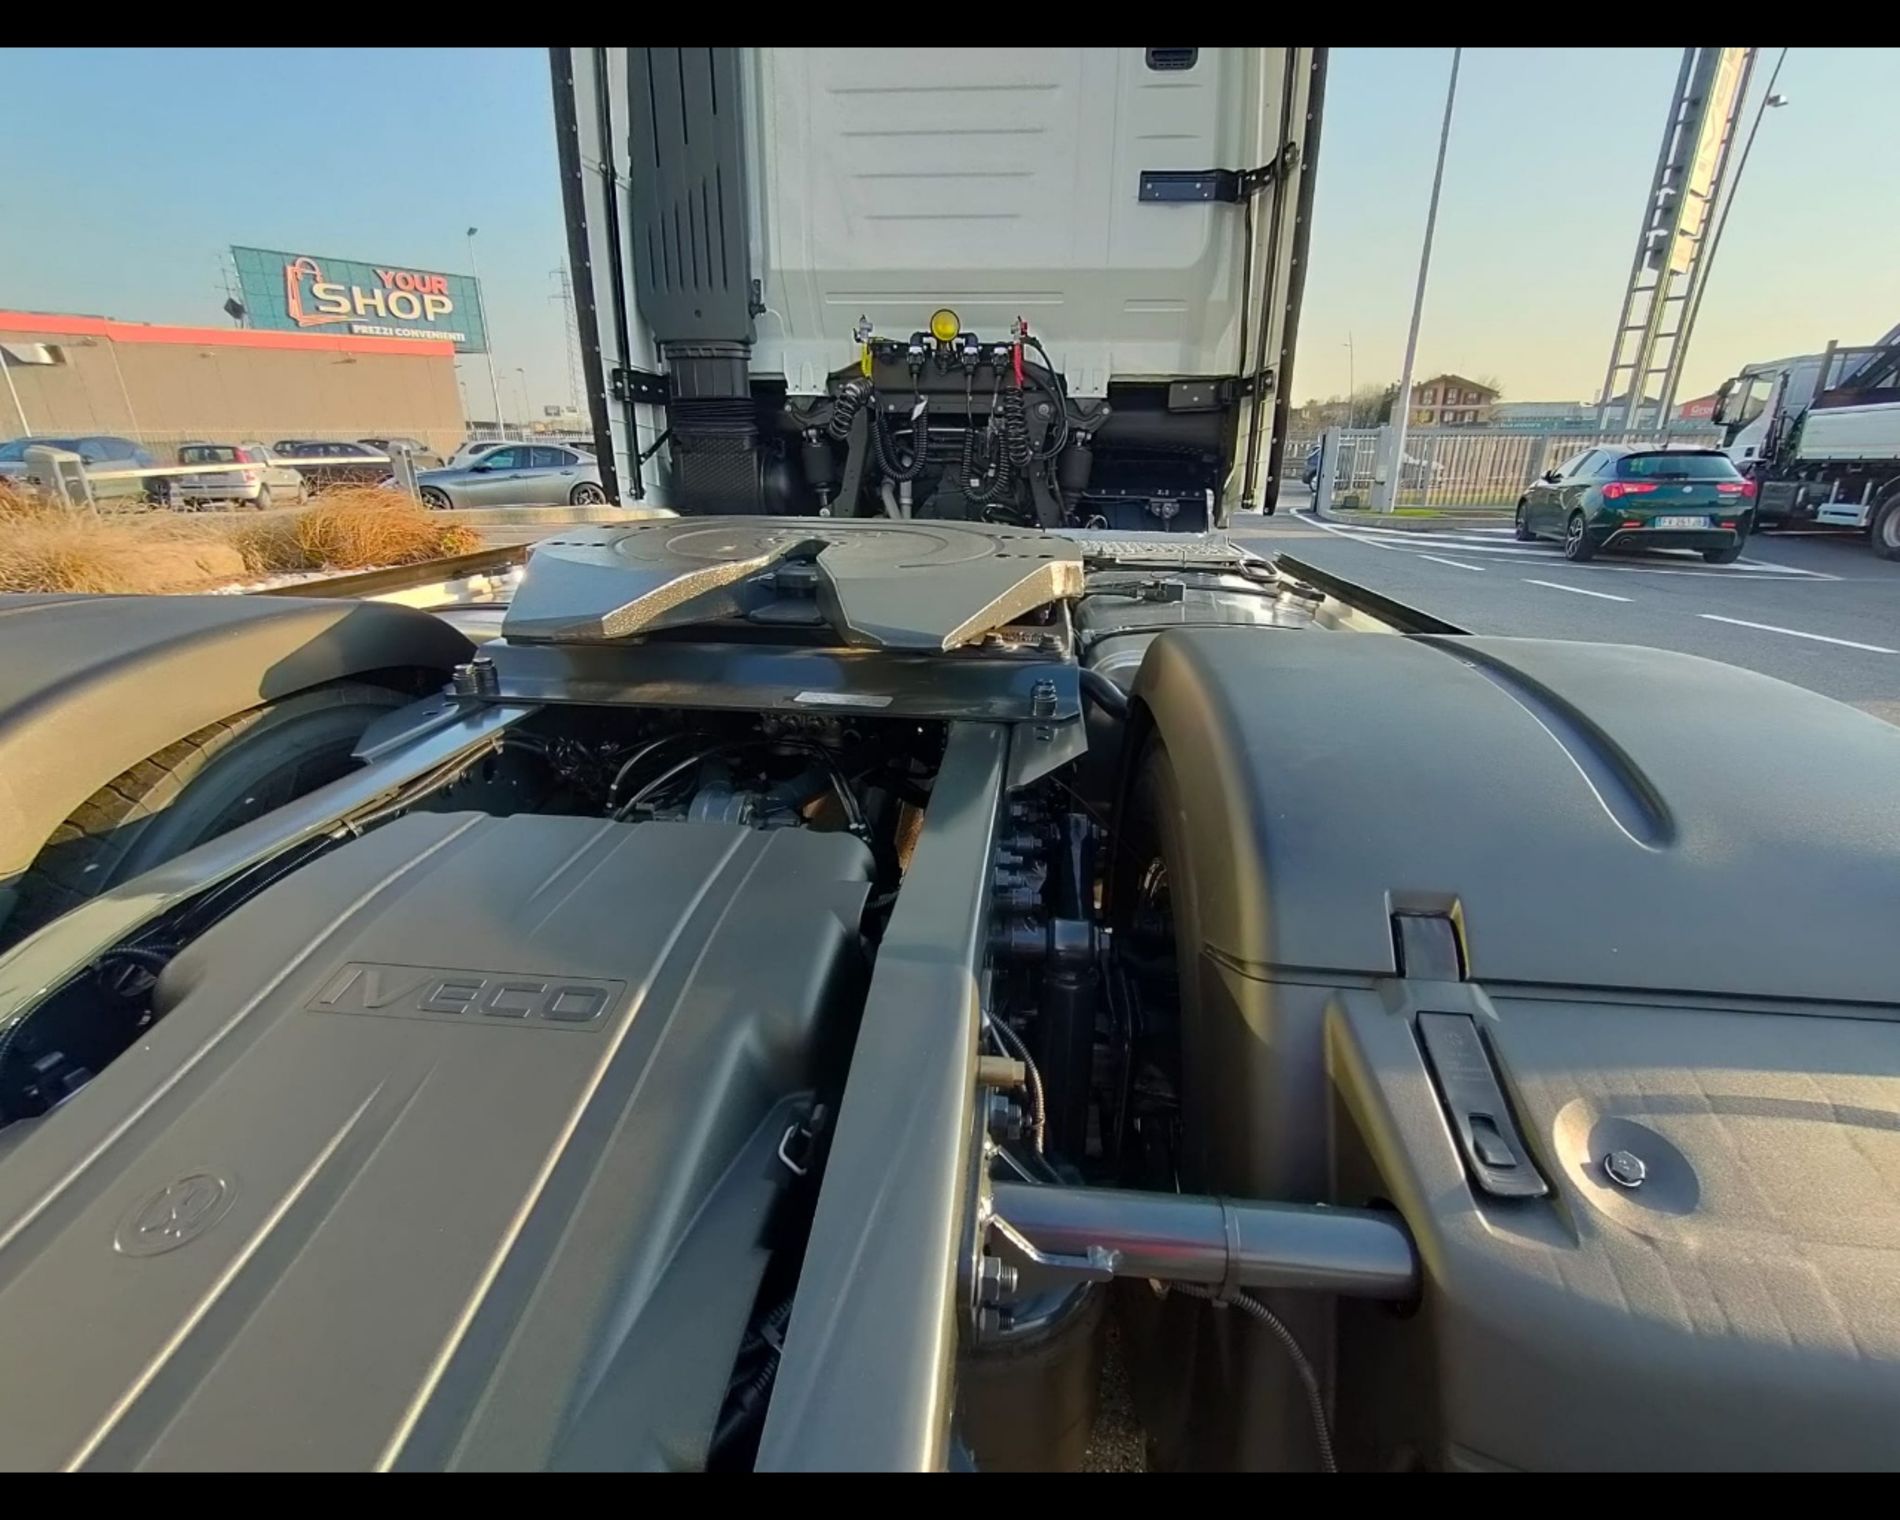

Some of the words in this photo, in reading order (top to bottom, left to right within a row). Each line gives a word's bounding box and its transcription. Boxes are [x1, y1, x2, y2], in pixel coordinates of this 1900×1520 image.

[375, 269, 449, 294] YOUR
[312, 283, 453, 321] SHOP
[352, 324, 394, 336] PREZZI
[395, 327, 465, 341] CONVENIENTI
[319, 969, 610, 1023] IVECO
